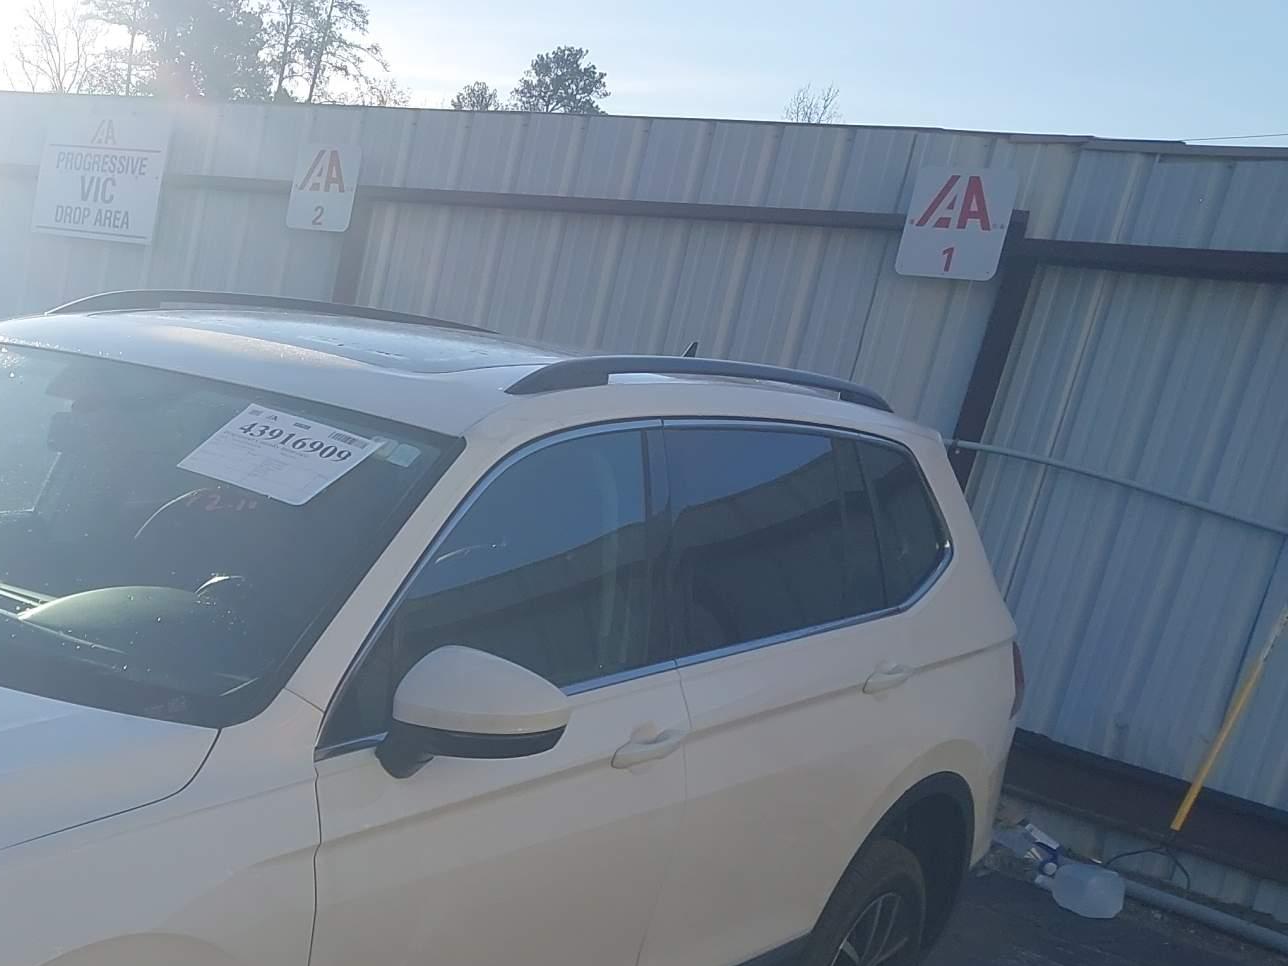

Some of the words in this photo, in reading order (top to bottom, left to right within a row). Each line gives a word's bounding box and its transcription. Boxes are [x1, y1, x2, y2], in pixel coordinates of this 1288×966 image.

[56, 151, 148, 175] PROGRESSIVE
[80, 175, 116, 204] VIC
[54, 205, 90, 225] DROP
[94, 209, 129, 229] AREA
[312, 206, 324, 225] 2
[942, 247, 955, 272] 1
[239, 422, 352, 462] 43916909
